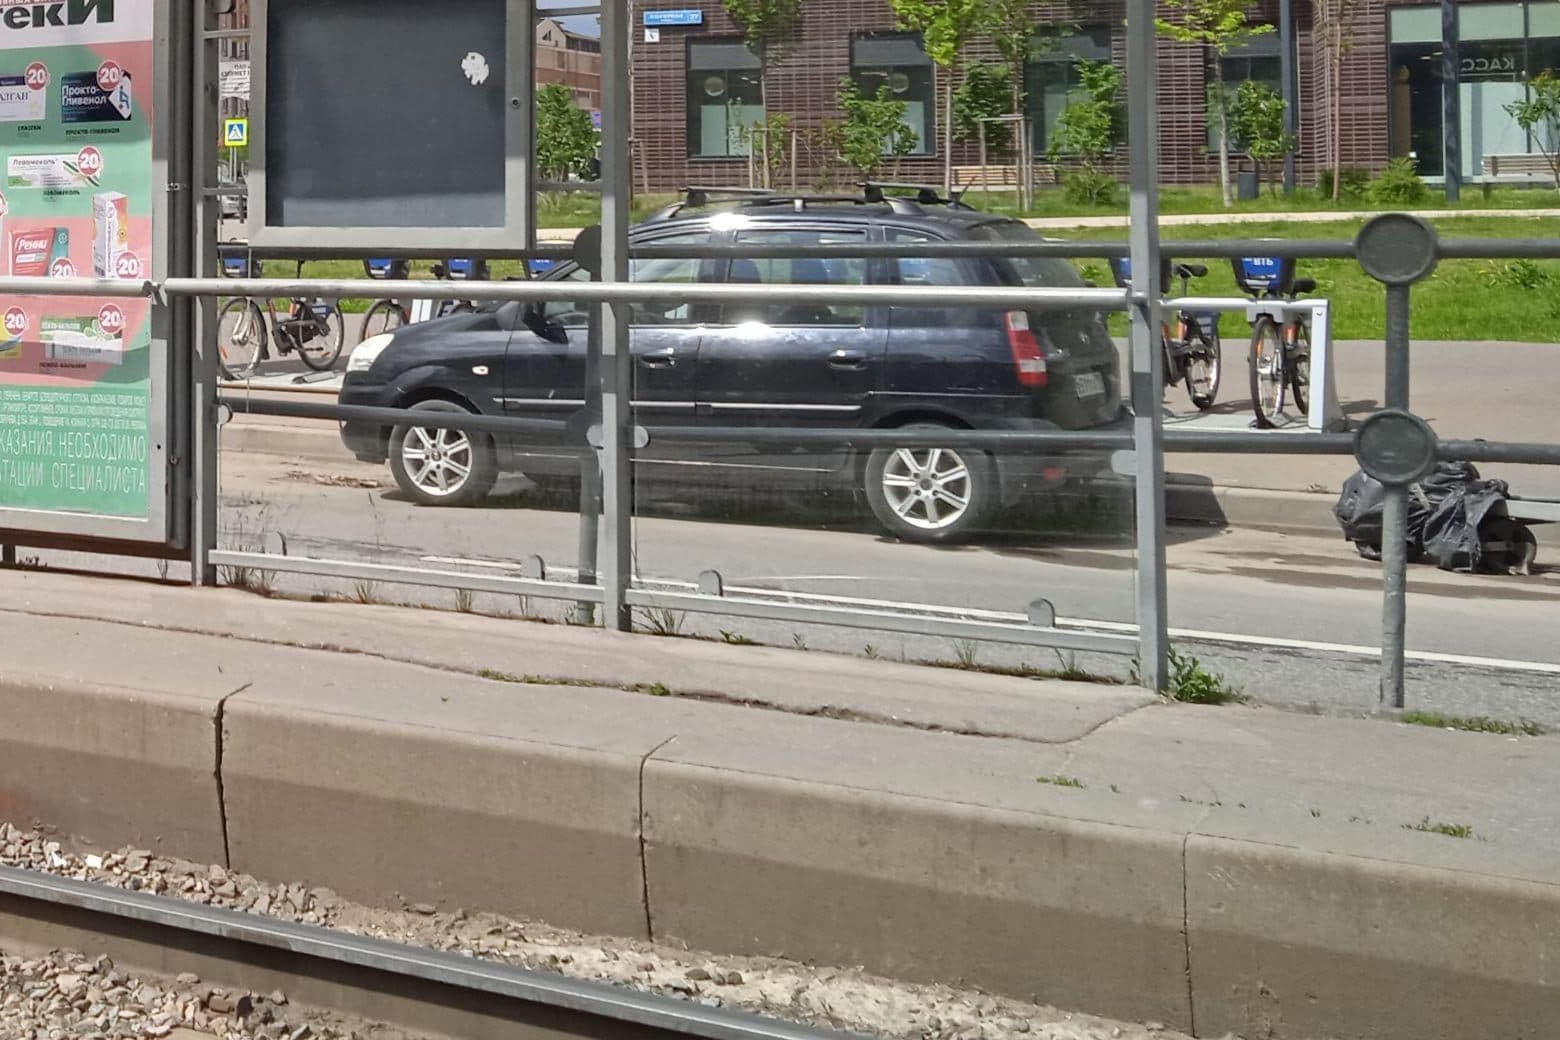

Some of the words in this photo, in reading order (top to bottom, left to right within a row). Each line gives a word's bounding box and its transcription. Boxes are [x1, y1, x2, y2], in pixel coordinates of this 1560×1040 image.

[62, 84, 100, 96] Прокто-
[62, 95, 106, 106] Гливенол
[59, 431, 145, 462] НЕОБХОДИМО
[51, 462, 145, 493] СПЕЦИАЛИСТА
